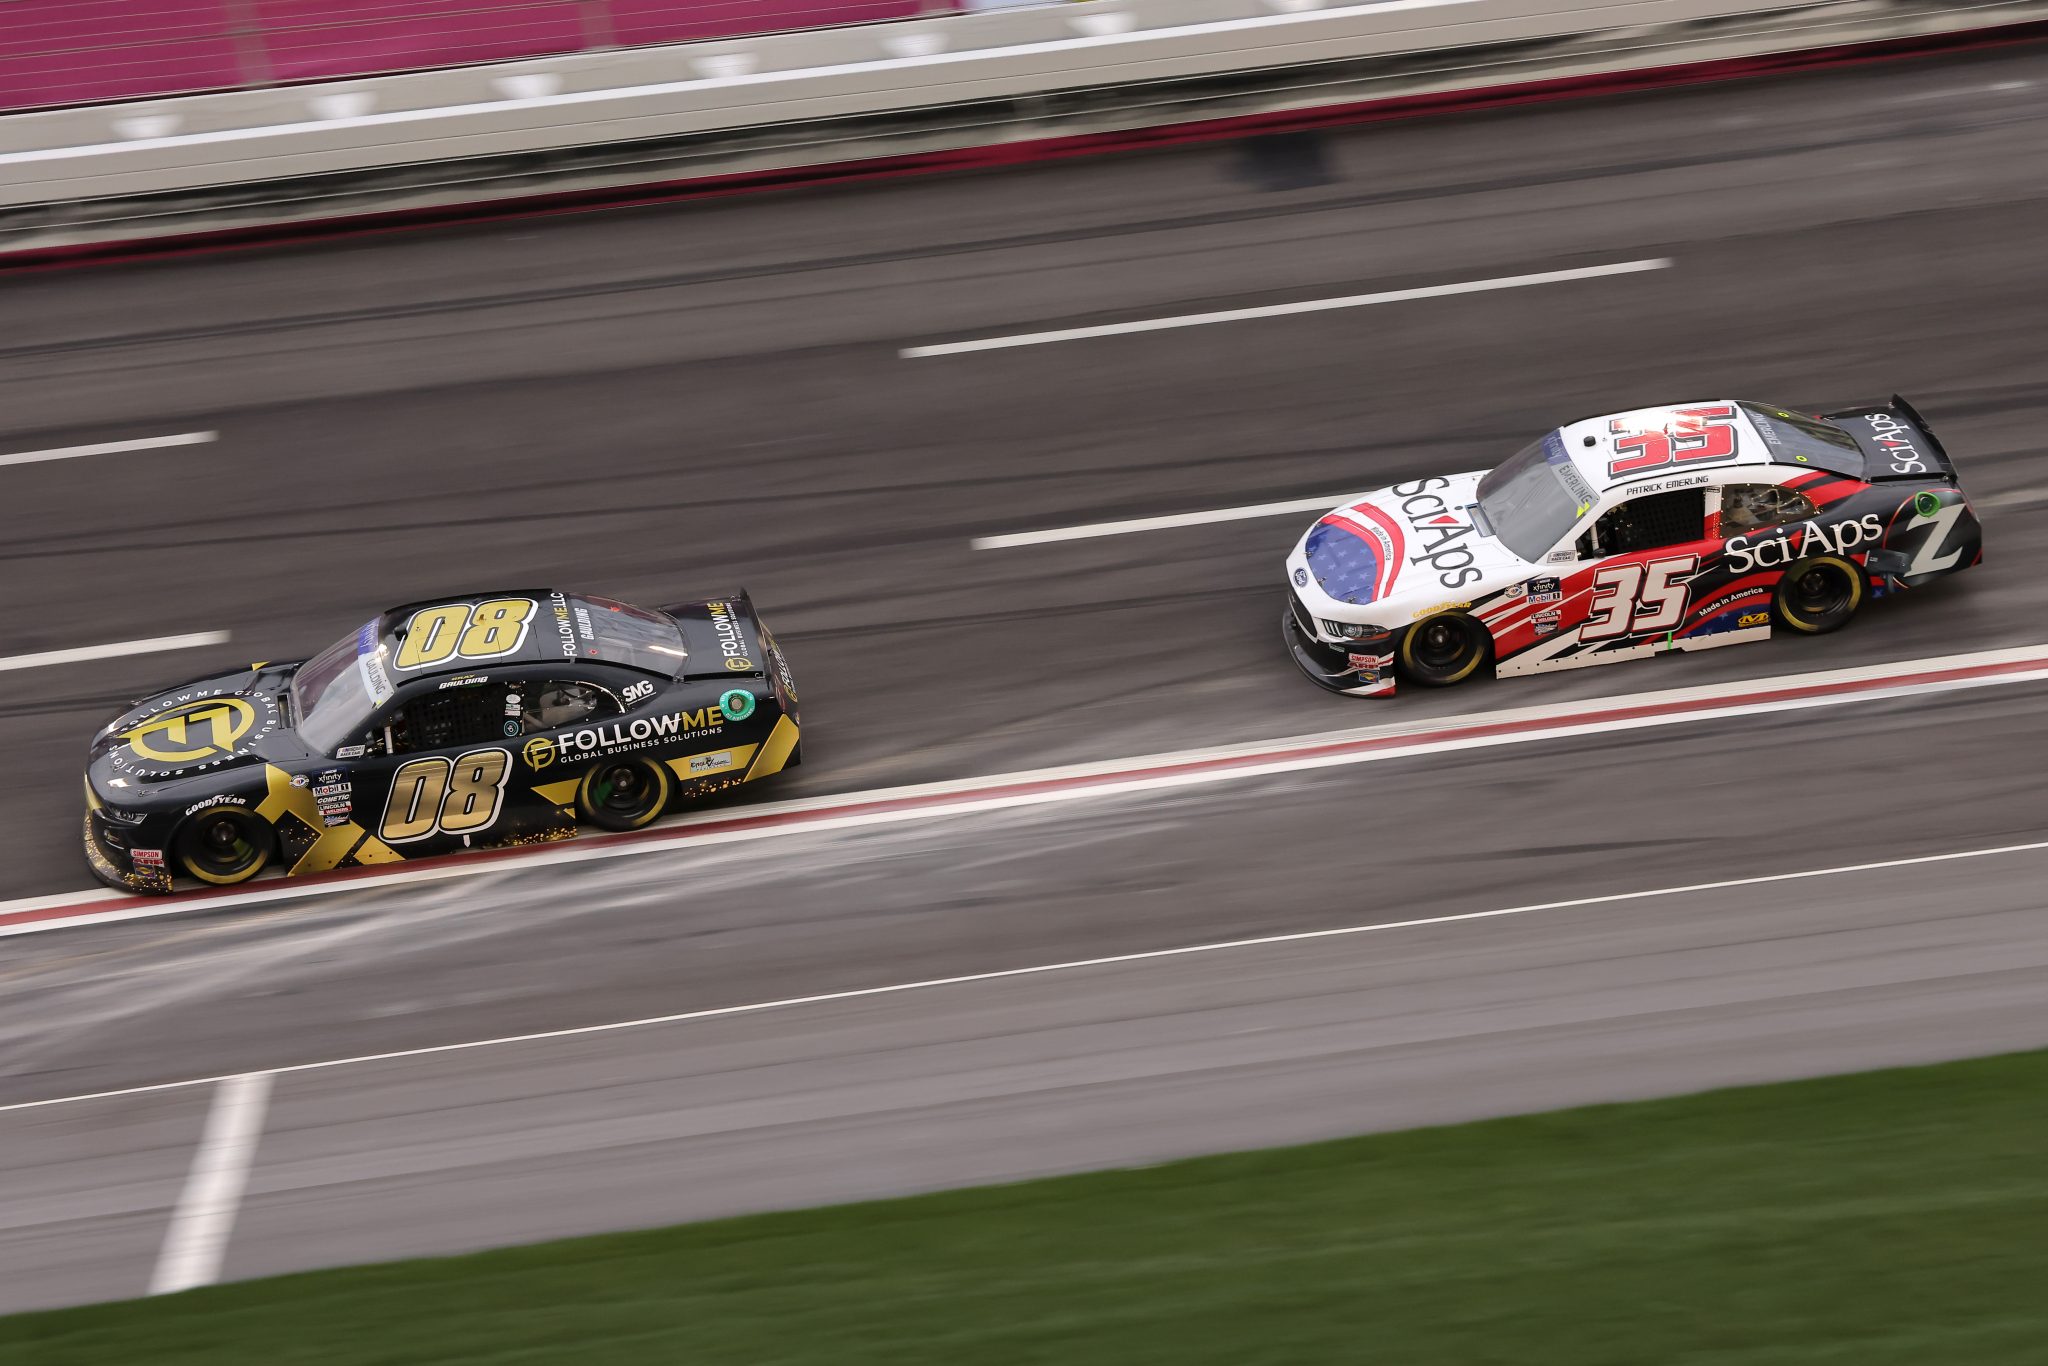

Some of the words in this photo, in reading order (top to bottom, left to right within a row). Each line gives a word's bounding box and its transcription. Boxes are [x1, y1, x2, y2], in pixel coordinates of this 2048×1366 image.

[1626, 482, 1662, 496] PATRICK
[1665, 475, 1709, 490] EMERLING
[1391, 476, 1483, 589] SciAps
[1528, 594, 1551, 604] Mobil
[1532, 583, 1555, 592] xfinity
[1578, 552, 1701, 646] 35
[1699, 602, 1720, 616] Made
[1731, 587, 1764, 601] America
[393, 598, 538, 671] 08
[550, 592, 578, 657] FOLLOWME.LLC
[706, 602, 741, 657] FOLLOWME
[438, 676, 489, 690] GAULDING
[622, 680, 655, 703] SMG
[557, 705, 724, 755] FOLLOWME
[560, 750, 604, 764] GLOBAL
[607, 738, 660, 755] BUSINESS
[663, 725, 723, 745] SOLUTIONS
[315, 785, 339, 796] Mobil
[318, 773, 342, 783] xfinity
[185, 794, 247, 816] GOODYEAR
[378, 747, 514, 845] 08
[132, 850, 160, 858] SIMPSON
